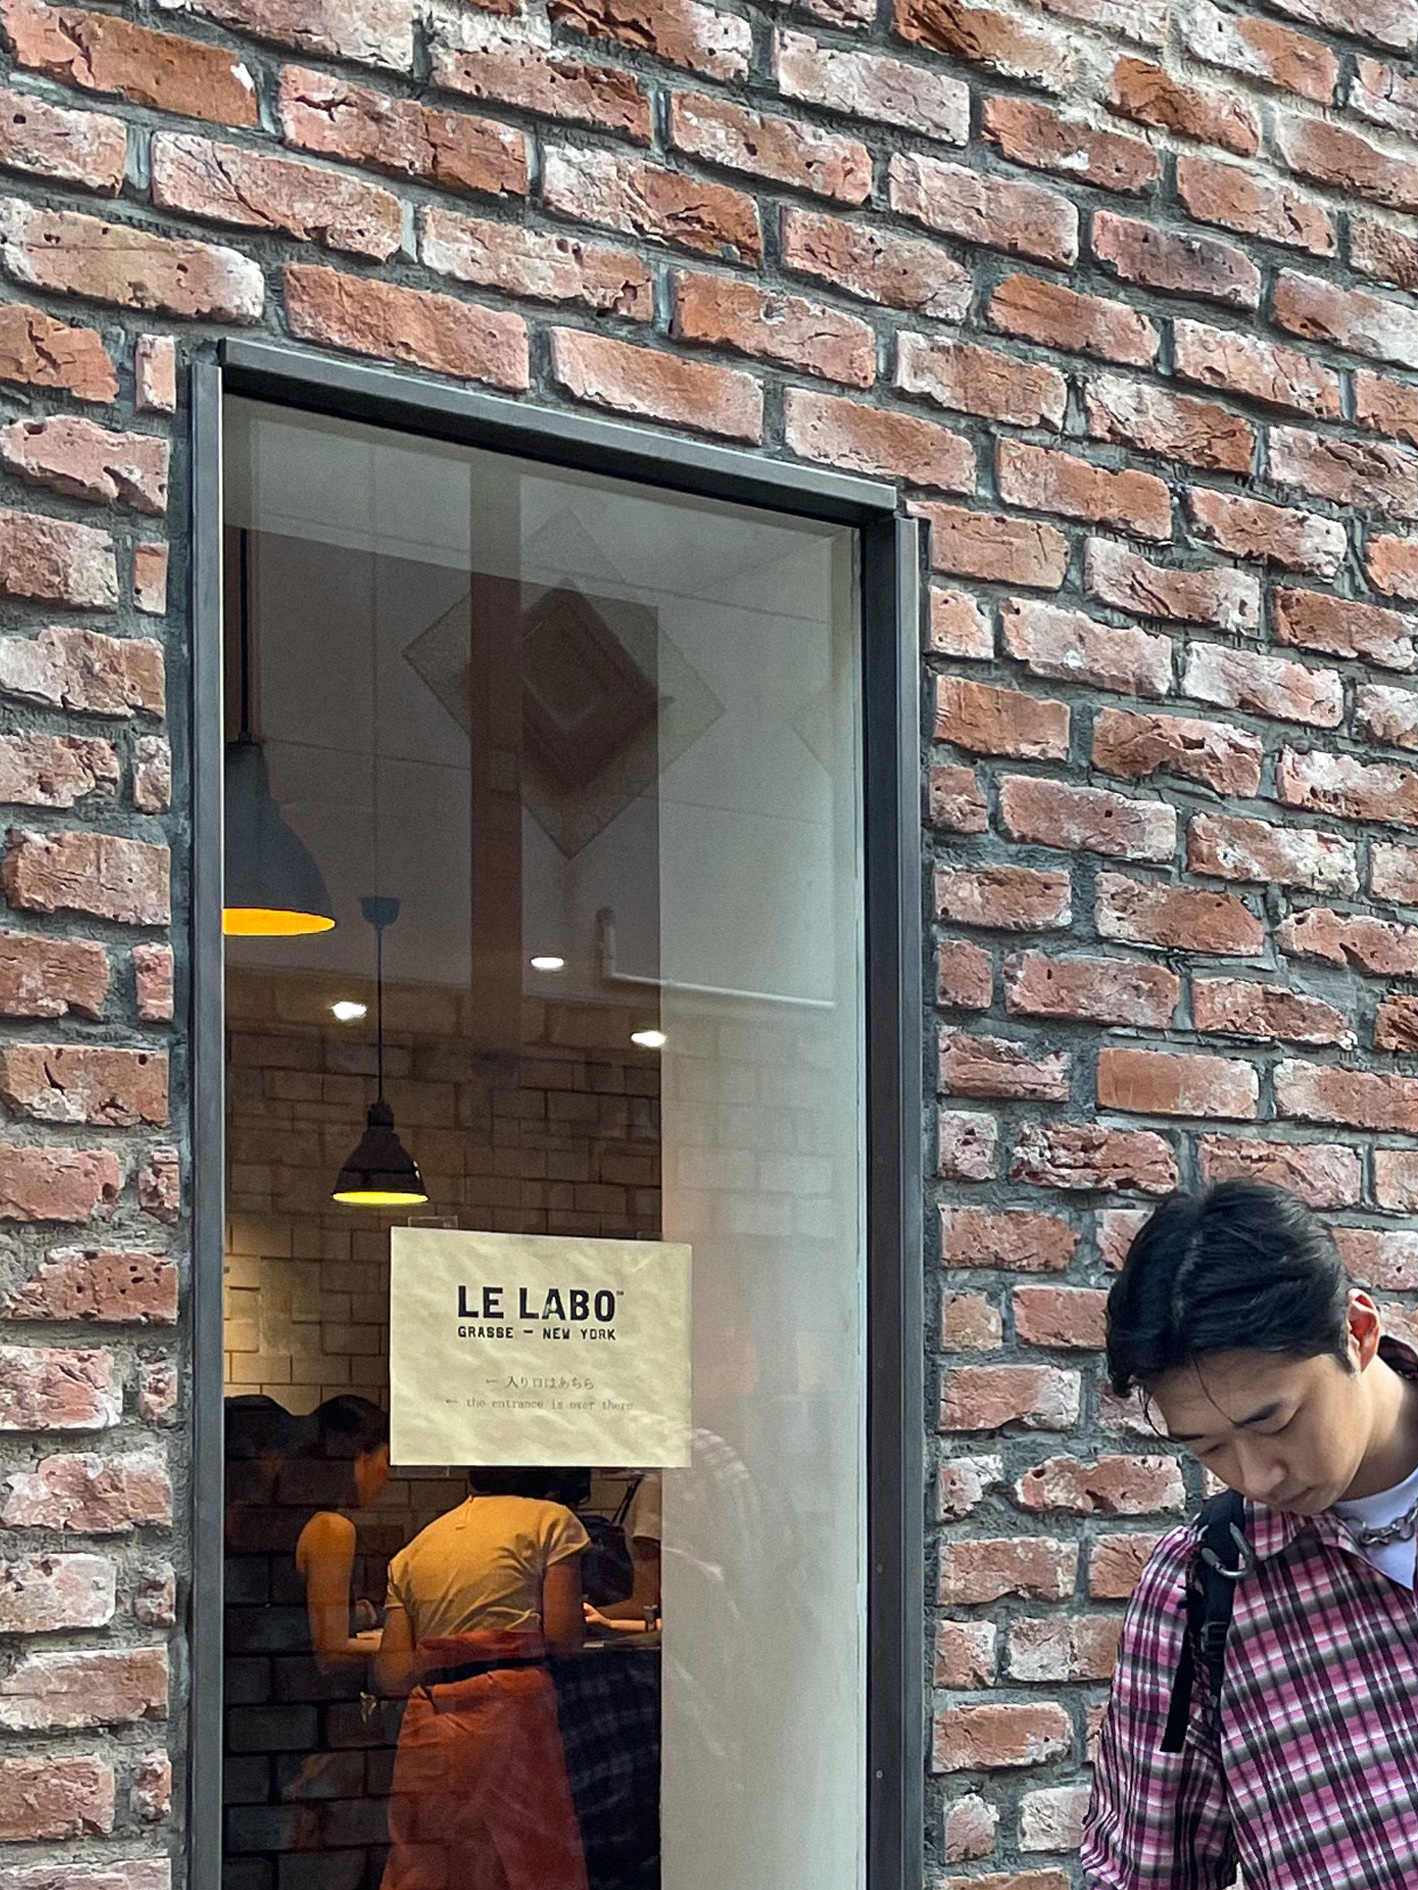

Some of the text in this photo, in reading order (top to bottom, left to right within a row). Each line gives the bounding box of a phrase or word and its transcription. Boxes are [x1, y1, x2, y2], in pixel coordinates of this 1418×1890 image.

[457, 1285, 505, 1319] LE
[457, 1325, 514, 1339] GRASSE
[543, 1327, 570, 1340] NEW
[580, 1328, 617, 1341] YORK
[505, 1375, 595, 1390] 入り口はあちら
[466, 1398, 486, 1409] the
[491, 1399, 544, 1410] entrance
[551, 1399, 564, 1410] is
